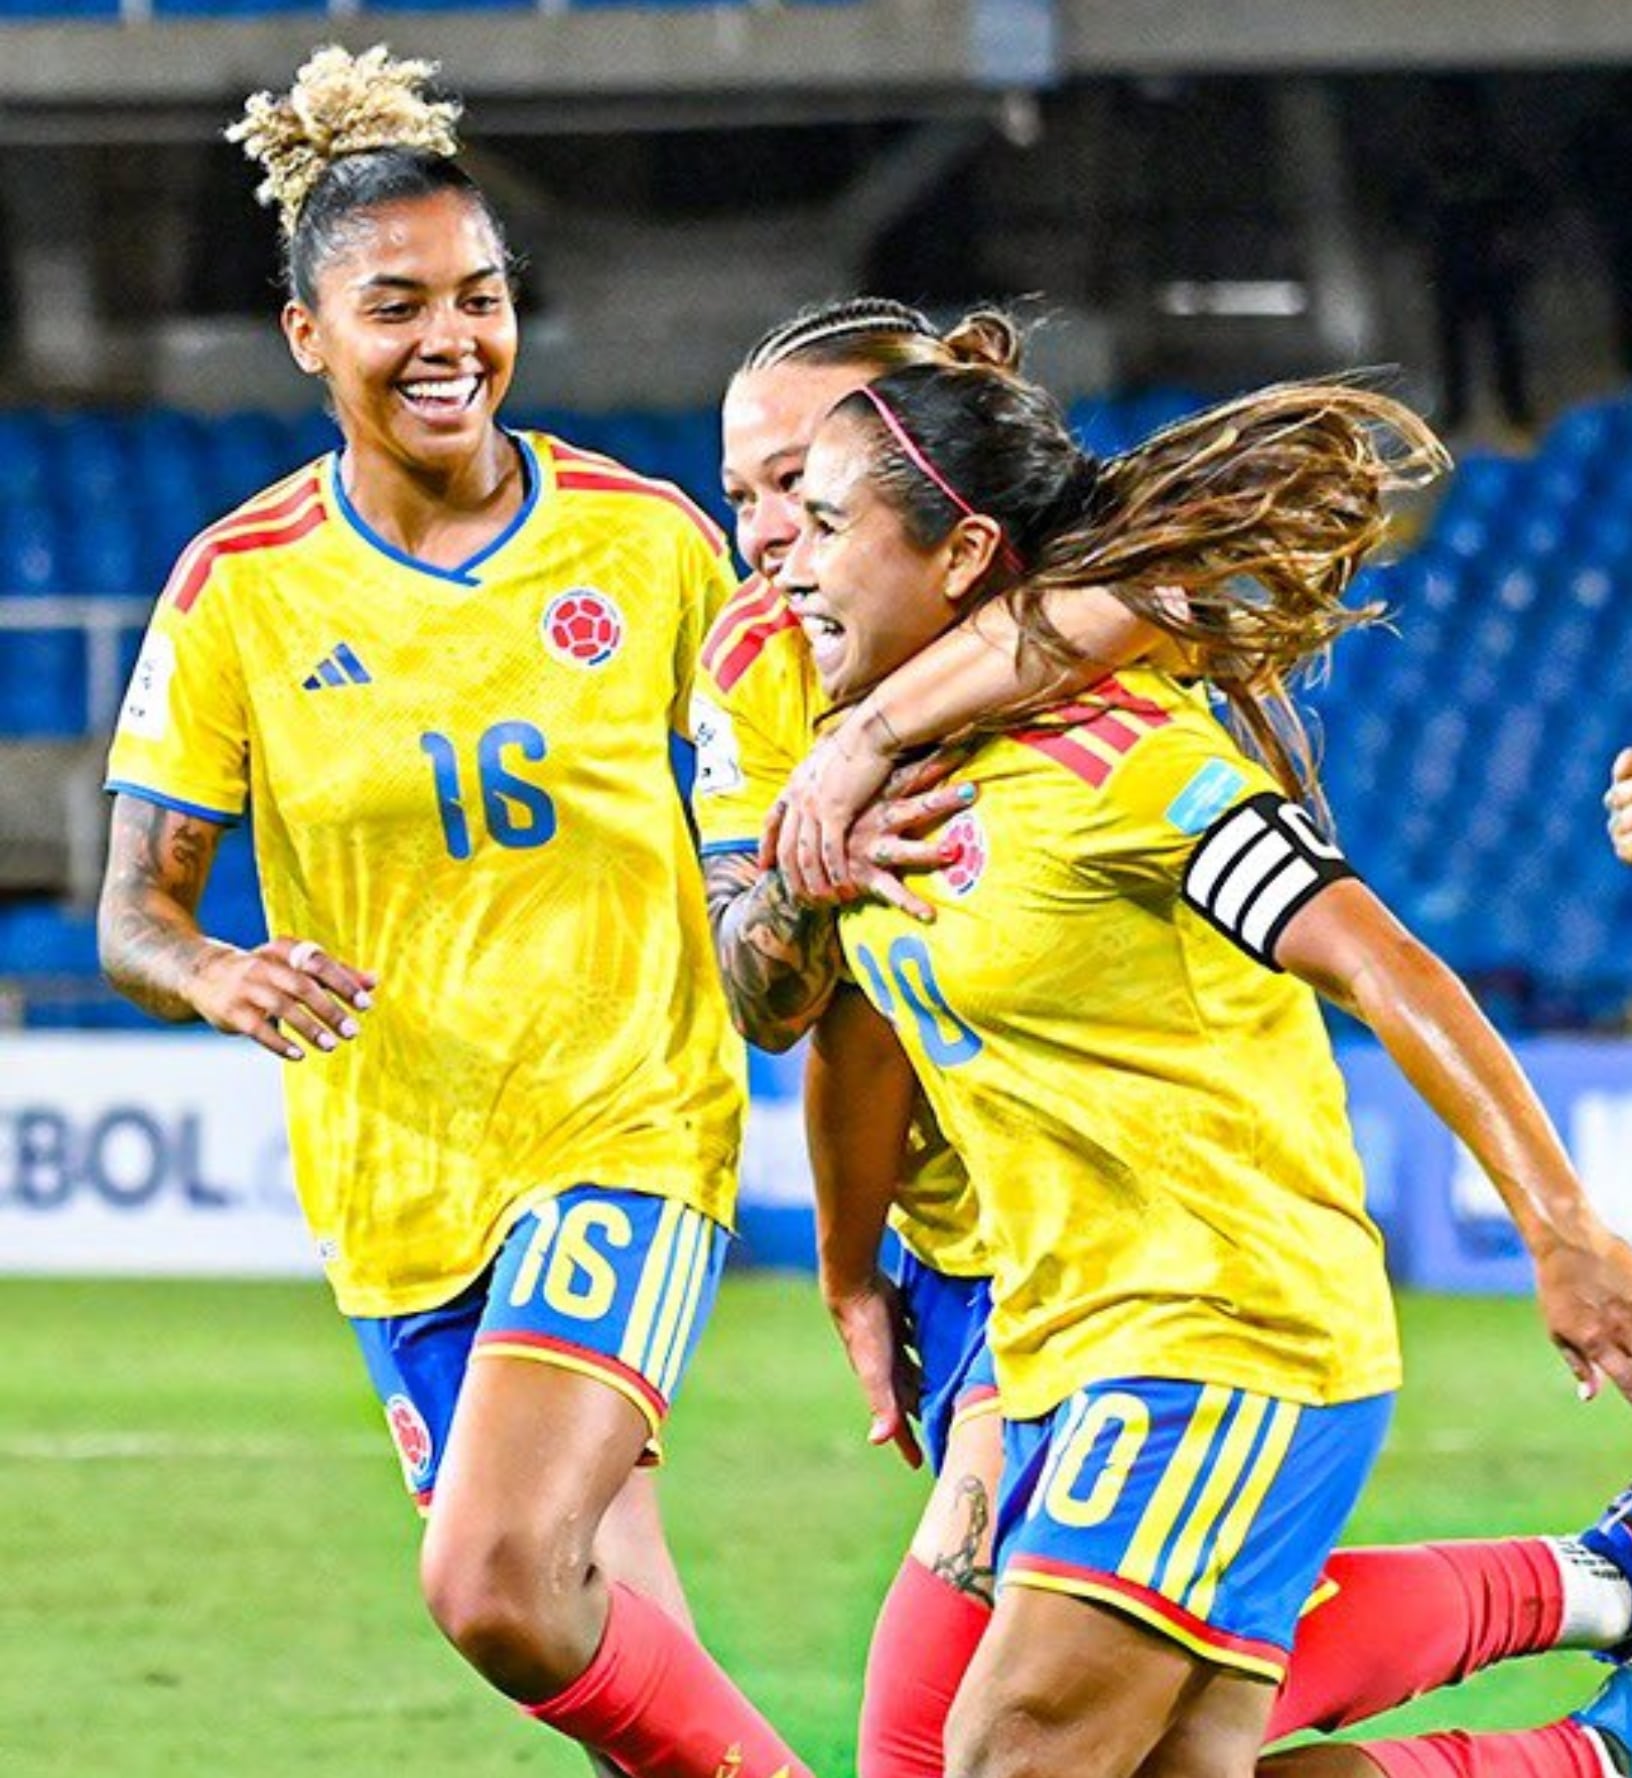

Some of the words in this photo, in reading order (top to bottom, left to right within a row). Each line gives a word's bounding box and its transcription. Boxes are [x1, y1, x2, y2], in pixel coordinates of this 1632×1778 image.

[420, 721, 557, 860] 16
[855, 936, 984, 1067] 10
[0, 1104, 232, 1208] BOL
[510, 1197, 633, 1321] 16
[1027, 1388, 1150, 1527] 10
